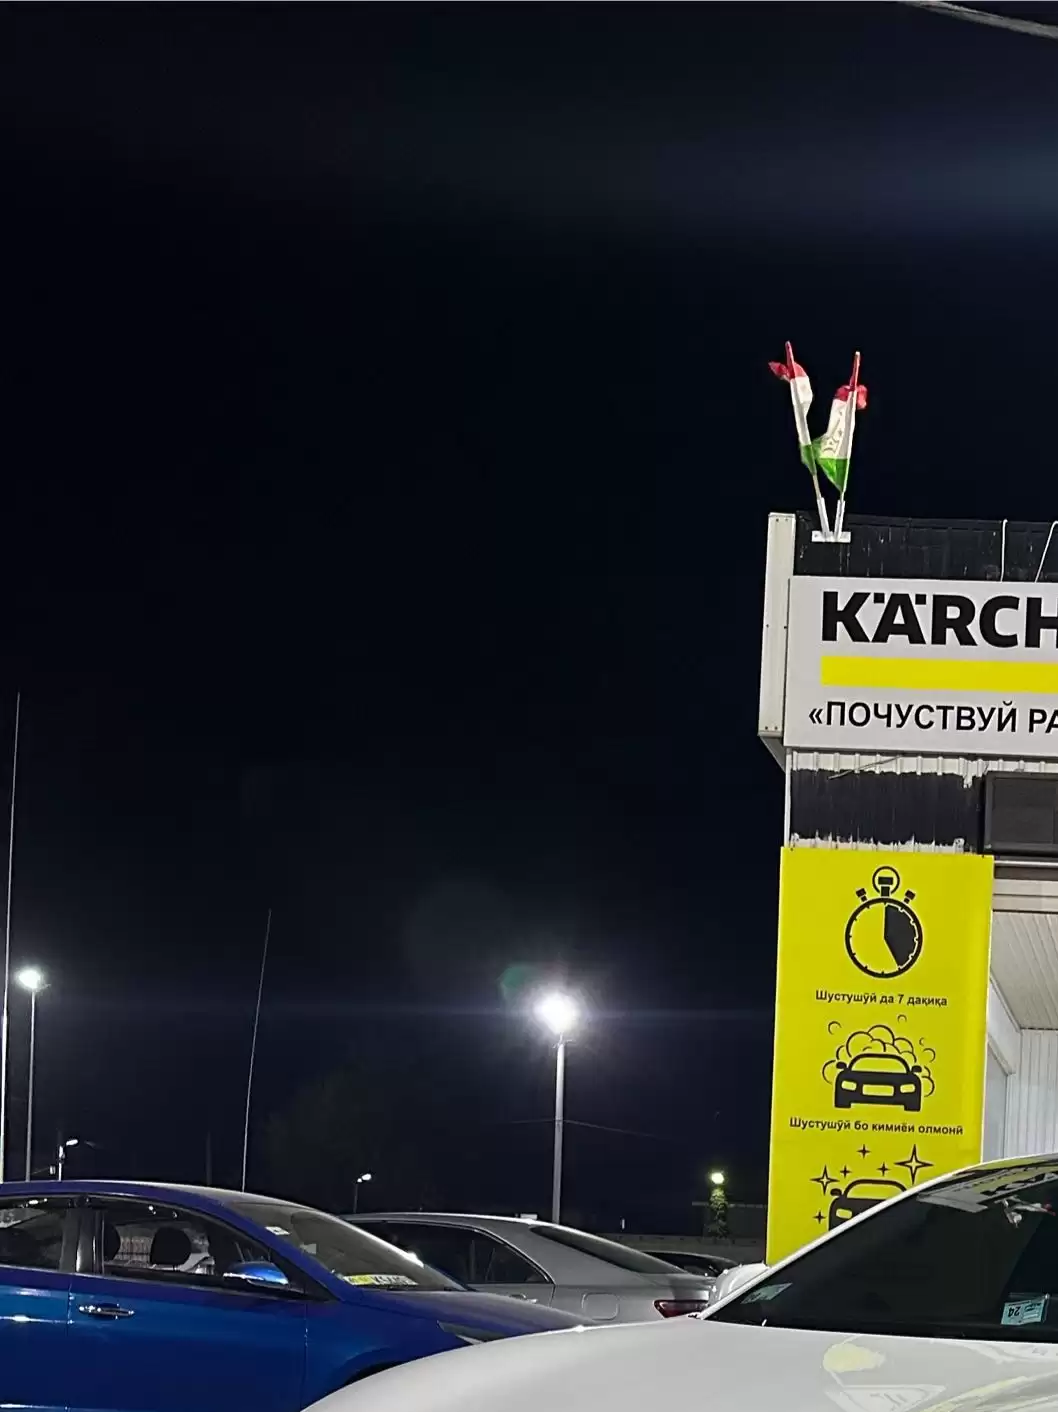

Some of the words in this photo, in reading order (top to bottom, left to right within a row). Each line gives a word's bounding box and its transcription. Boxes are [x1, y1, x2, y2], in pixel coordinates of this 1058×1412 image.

[808, 700, 1017, 732] «ПОЧУСТВУЙ
[880, 994, 894, 1004] да
[897, 994, 905, 1004] 7
[854, 1120, 869, 1131] бо
